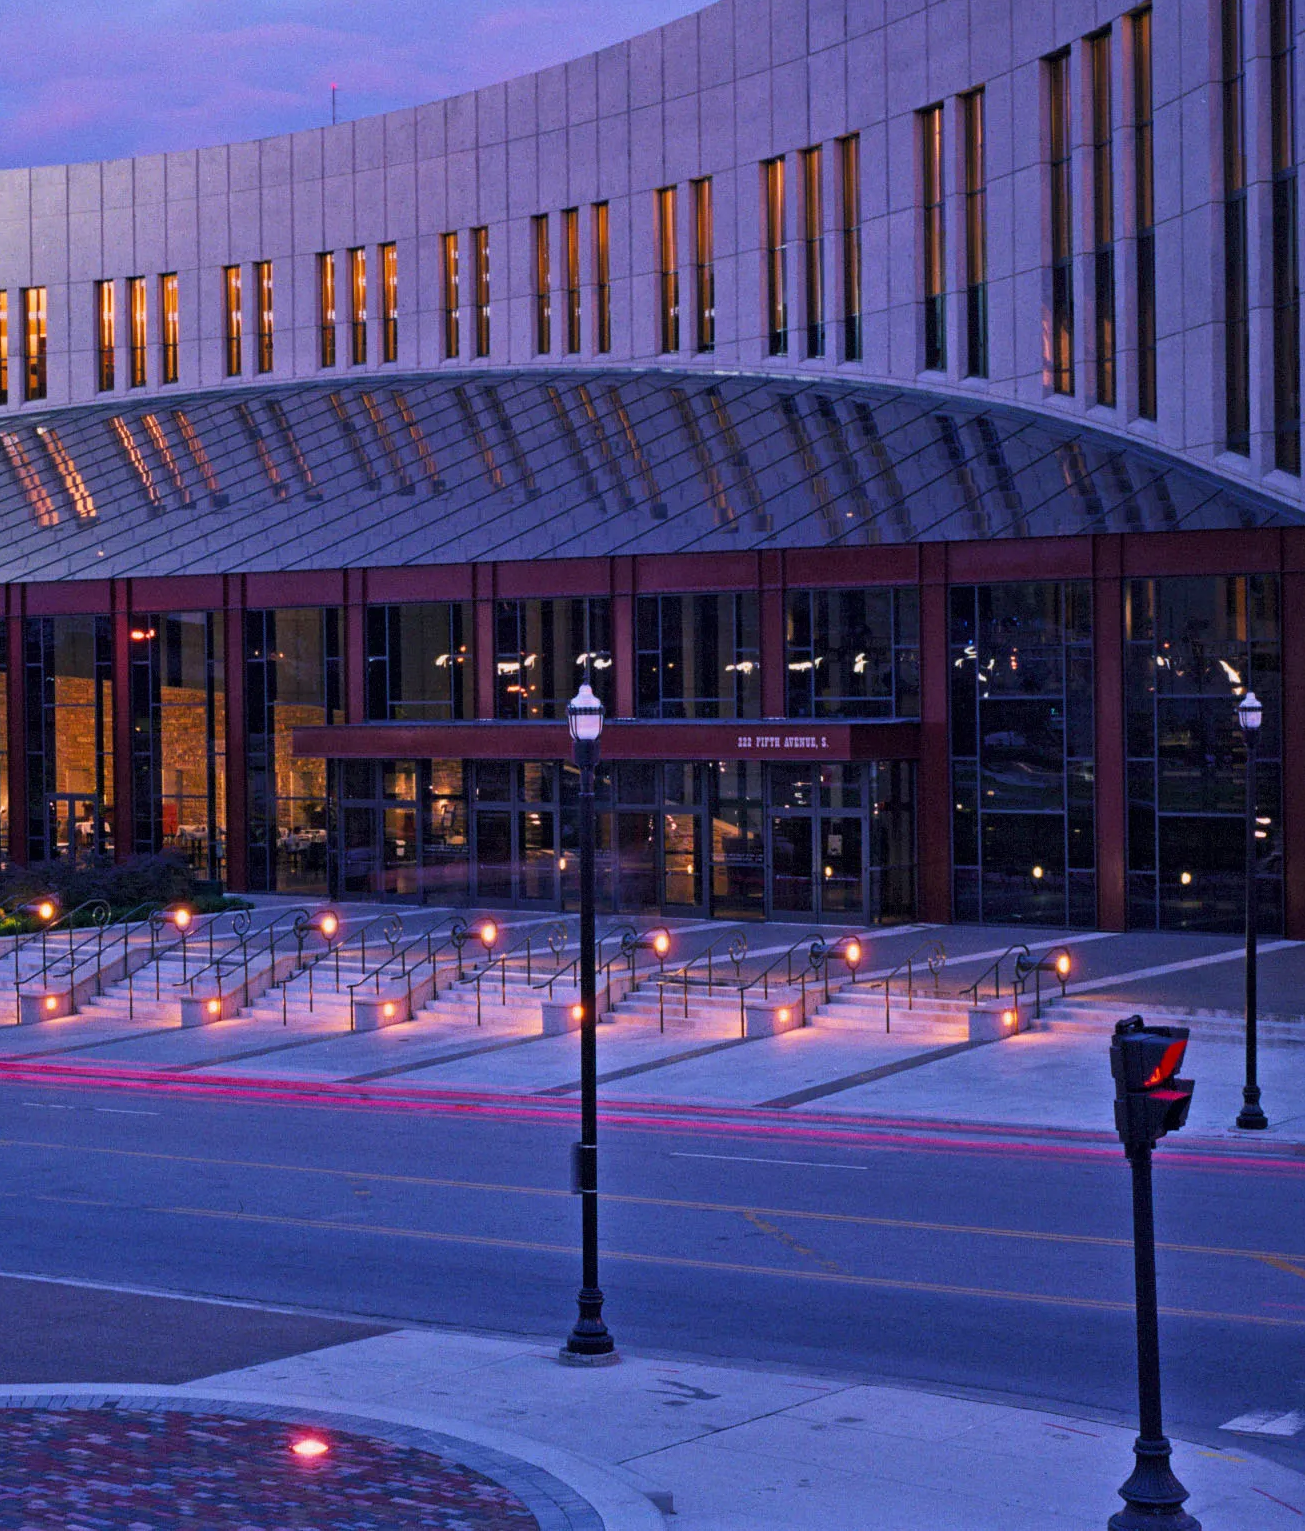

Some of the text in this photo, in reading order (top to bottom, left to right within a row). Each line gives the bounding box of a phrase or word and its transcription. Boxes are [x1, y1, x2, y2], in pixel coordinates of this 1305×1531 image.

[737, 736, 830, 750] 222 FIFTH AVENUE, S.
